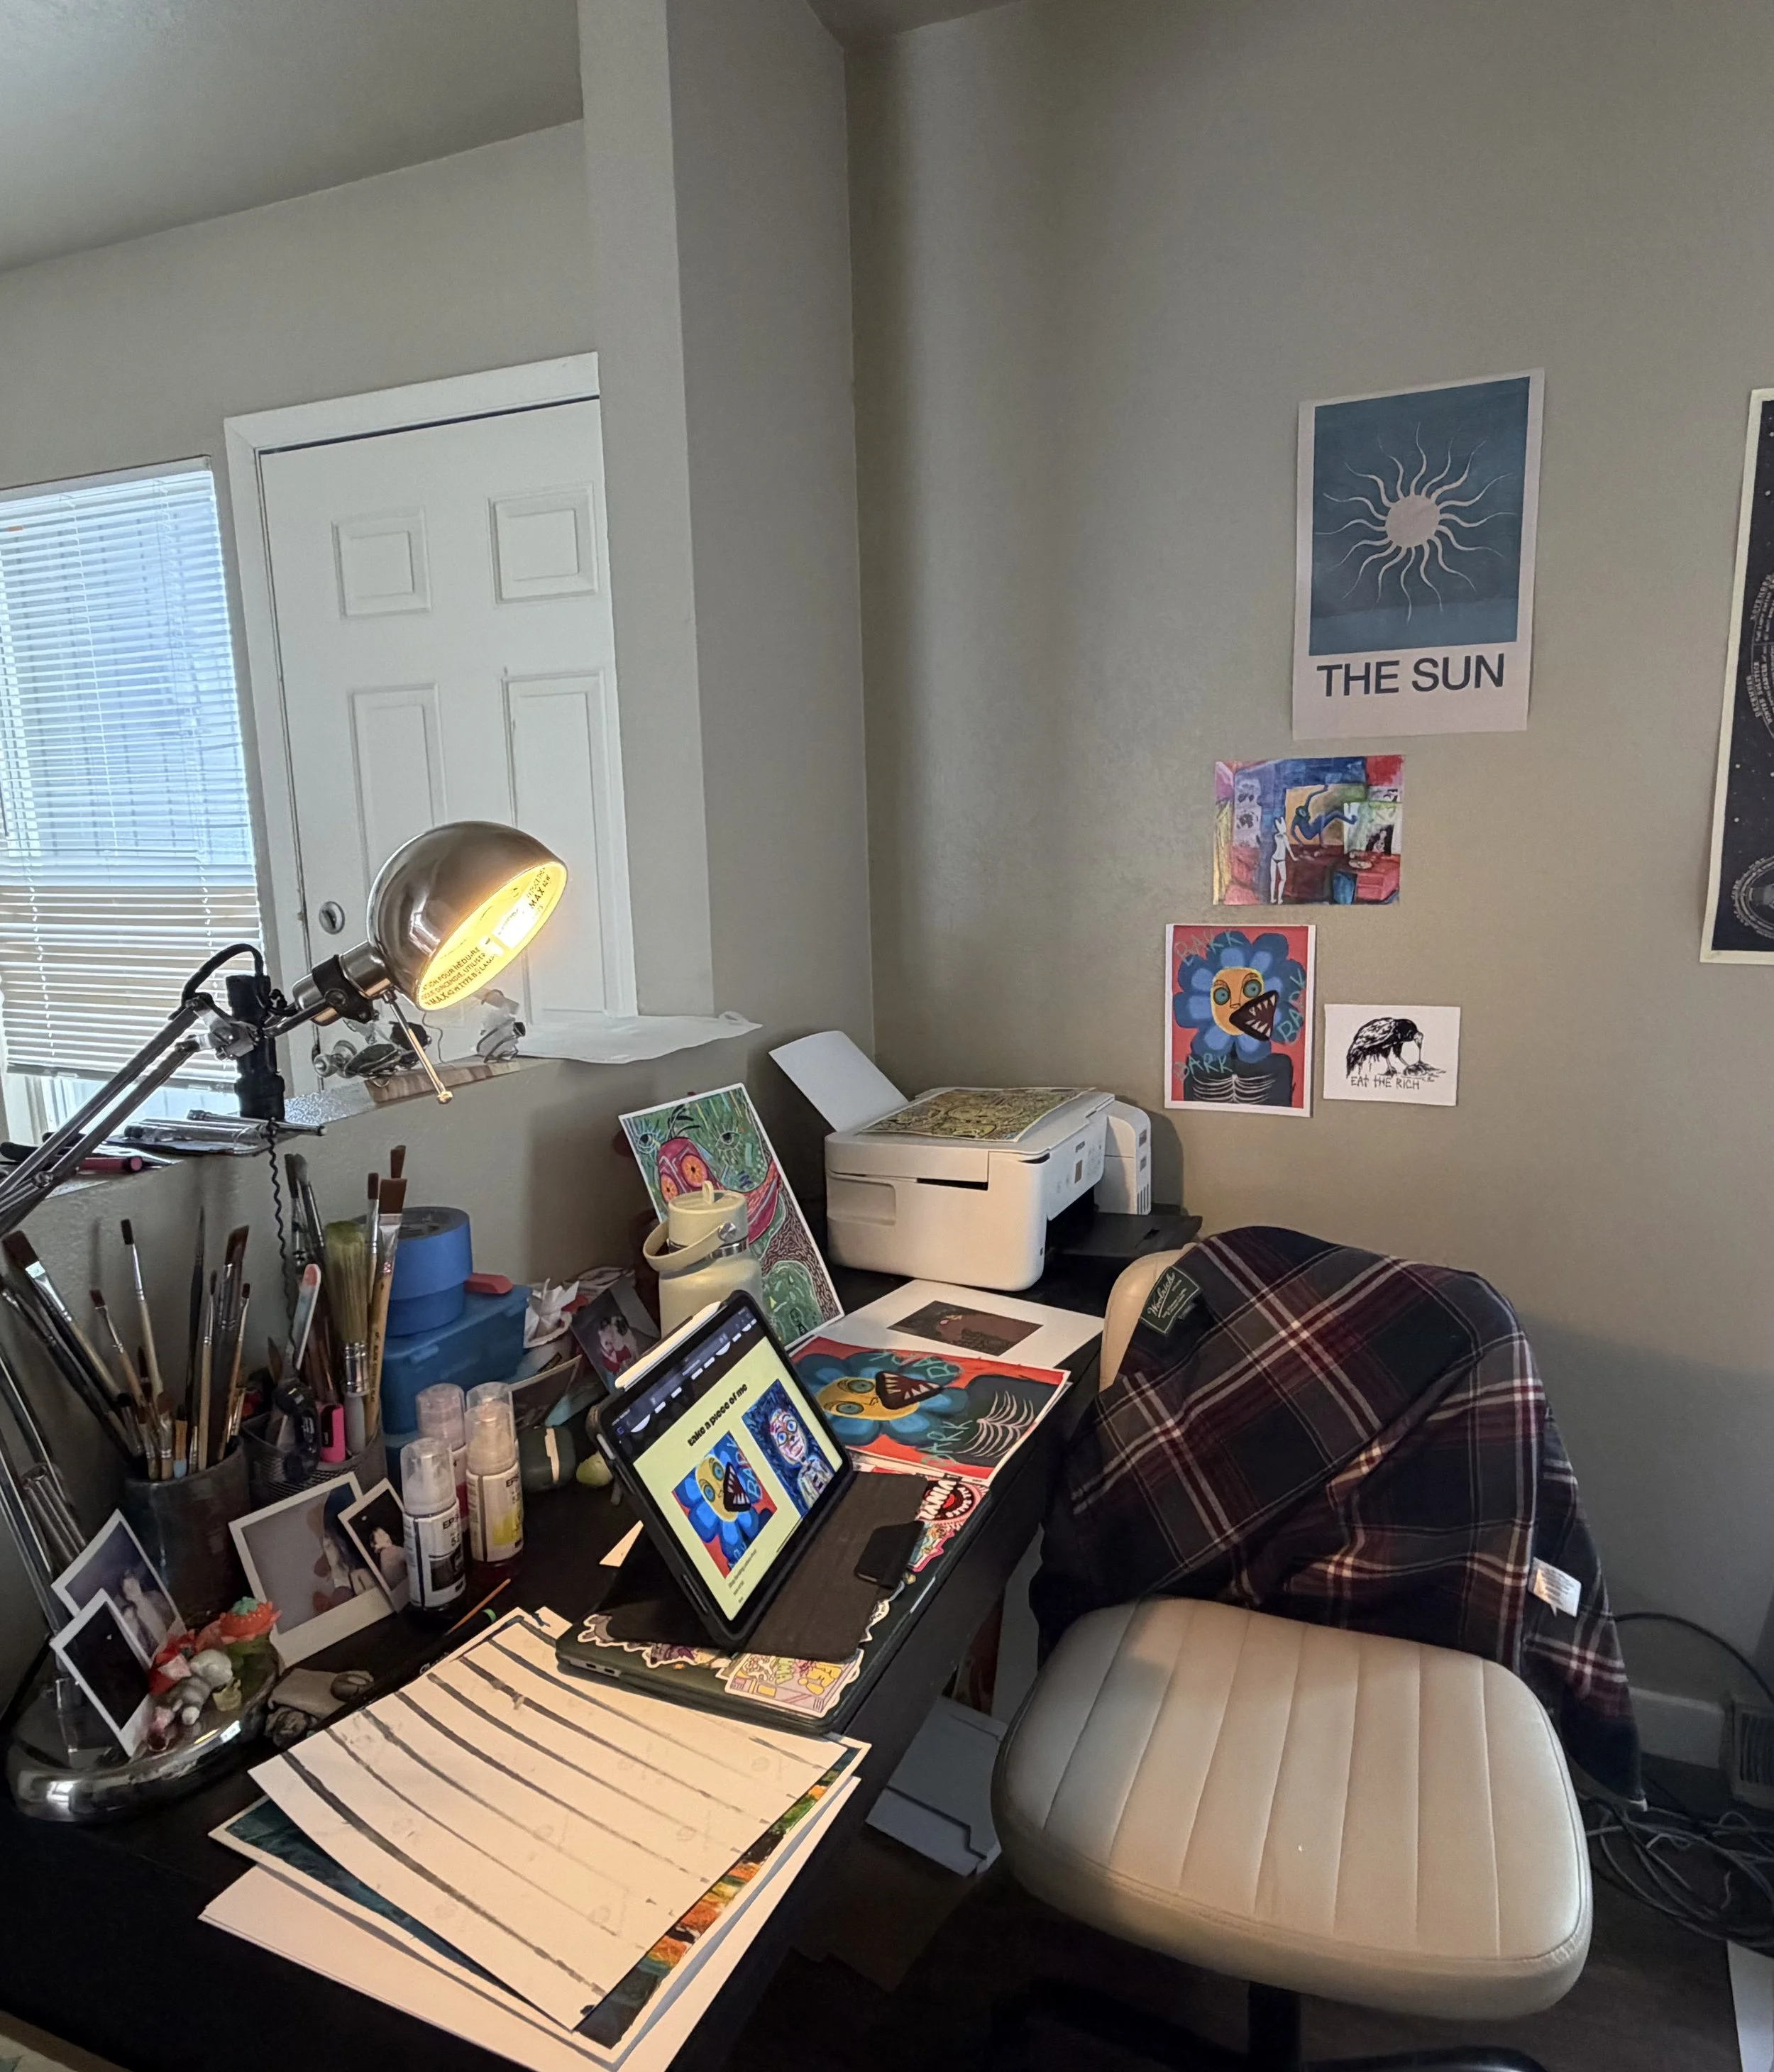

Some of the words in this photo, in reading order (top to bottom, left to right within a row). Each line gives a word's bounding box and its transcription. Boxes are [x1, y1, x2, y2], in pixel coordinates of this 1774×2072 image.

[1316, 660, 1400, 697] THE
[1411, 653, 1504, 693] SUN
[529, 887, 544, 908] MAX
[429, 992, 449, 1005] MAX
[1396, 1078, 1420, 1090] RICH
[1147, 1272, 1176, 1317] Woolrich
[688, 1426, 706, 1446] take
[705, 1421, 711, 1430] a
[709, 1402, 730, 1426] piece
[729, 1392, 737, 1405] of
[736, 1384, 747, 1398] me
